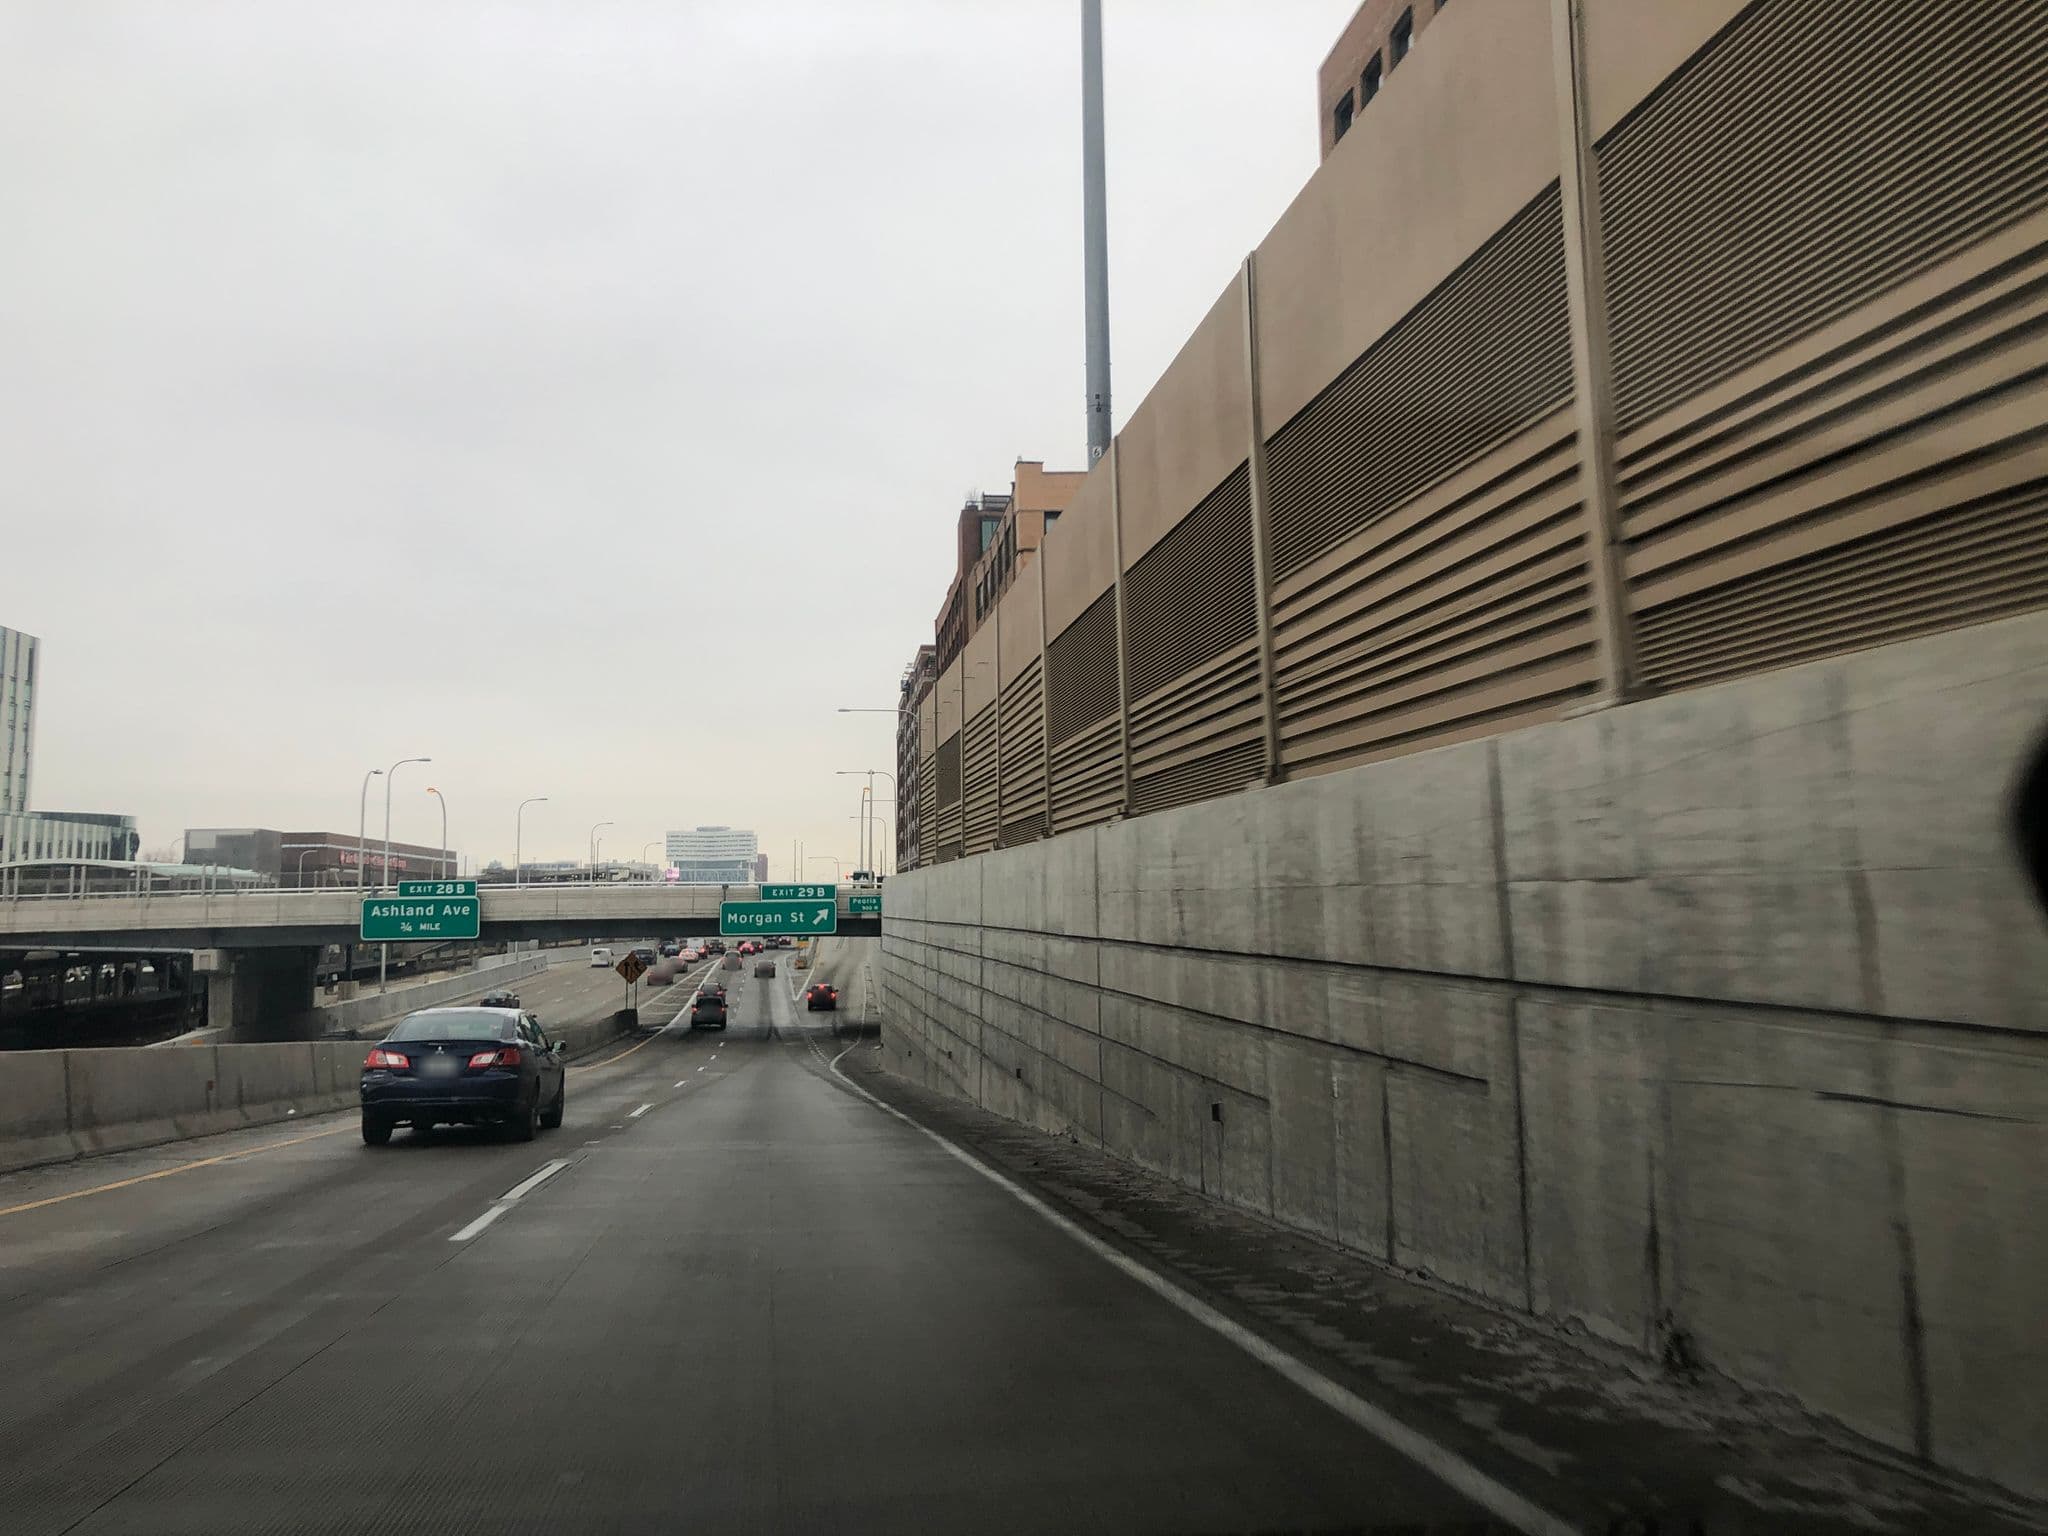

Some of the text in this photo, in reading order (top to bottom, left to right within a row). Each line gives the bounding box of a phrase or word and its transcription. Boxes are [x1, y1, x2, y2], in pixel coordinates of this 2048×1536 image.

[409, 884, 465, 895] EXIT 28 B
[772, 887, 825, 897] EXIT 29 B
[371, 904, 470, 917] Ashland Ave
[727, 912, 804, 926] Morgan St
[420, 923, 440, 931] MILE
